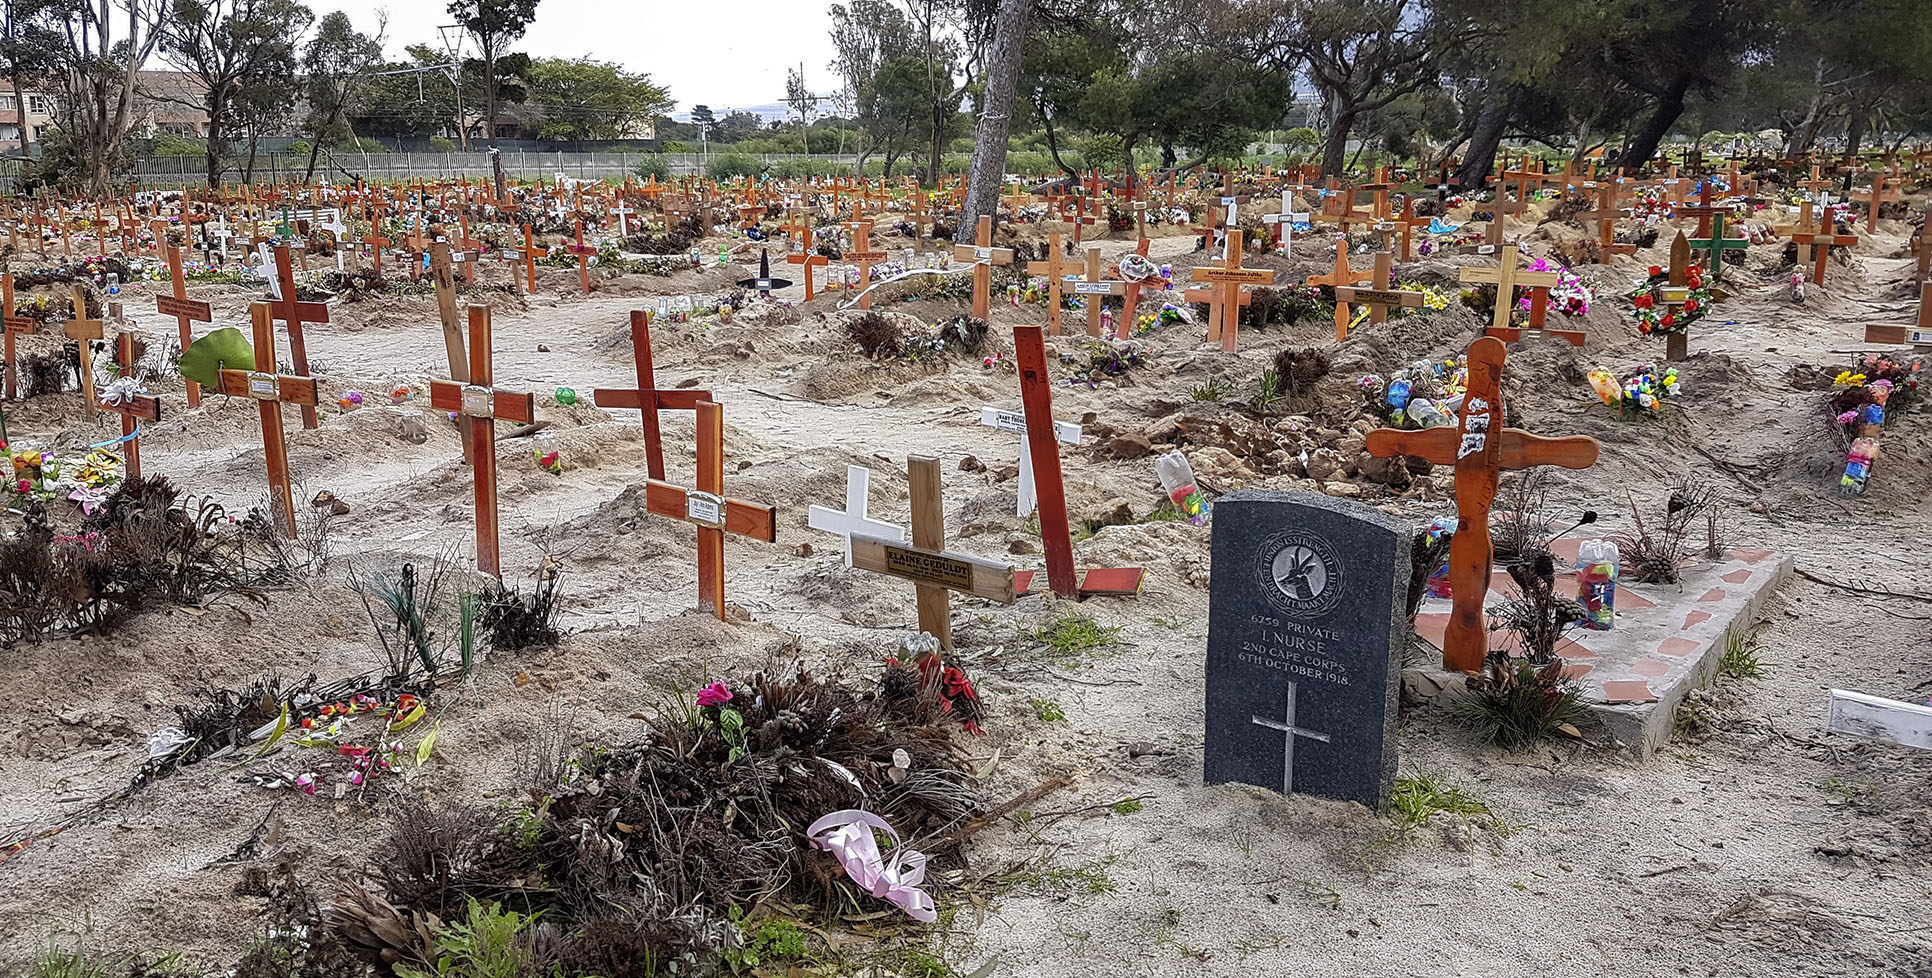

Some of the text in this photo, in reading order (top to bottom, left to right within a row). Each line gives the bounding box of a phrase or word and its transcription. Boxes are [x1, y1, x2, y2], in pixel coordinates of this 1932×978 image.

[888, 551, 921, 565] ELAINE
[1251, 614, 1340, 641] 6759 PRIVATE
[1243, 641, 1346, 673] 2ND CAPE CORPS
[1273, 632, 1326, 655] NURSE
[1238, 652, 1262, 665] 6TH
[1265, 658, 1322, 680] OCTOBER
